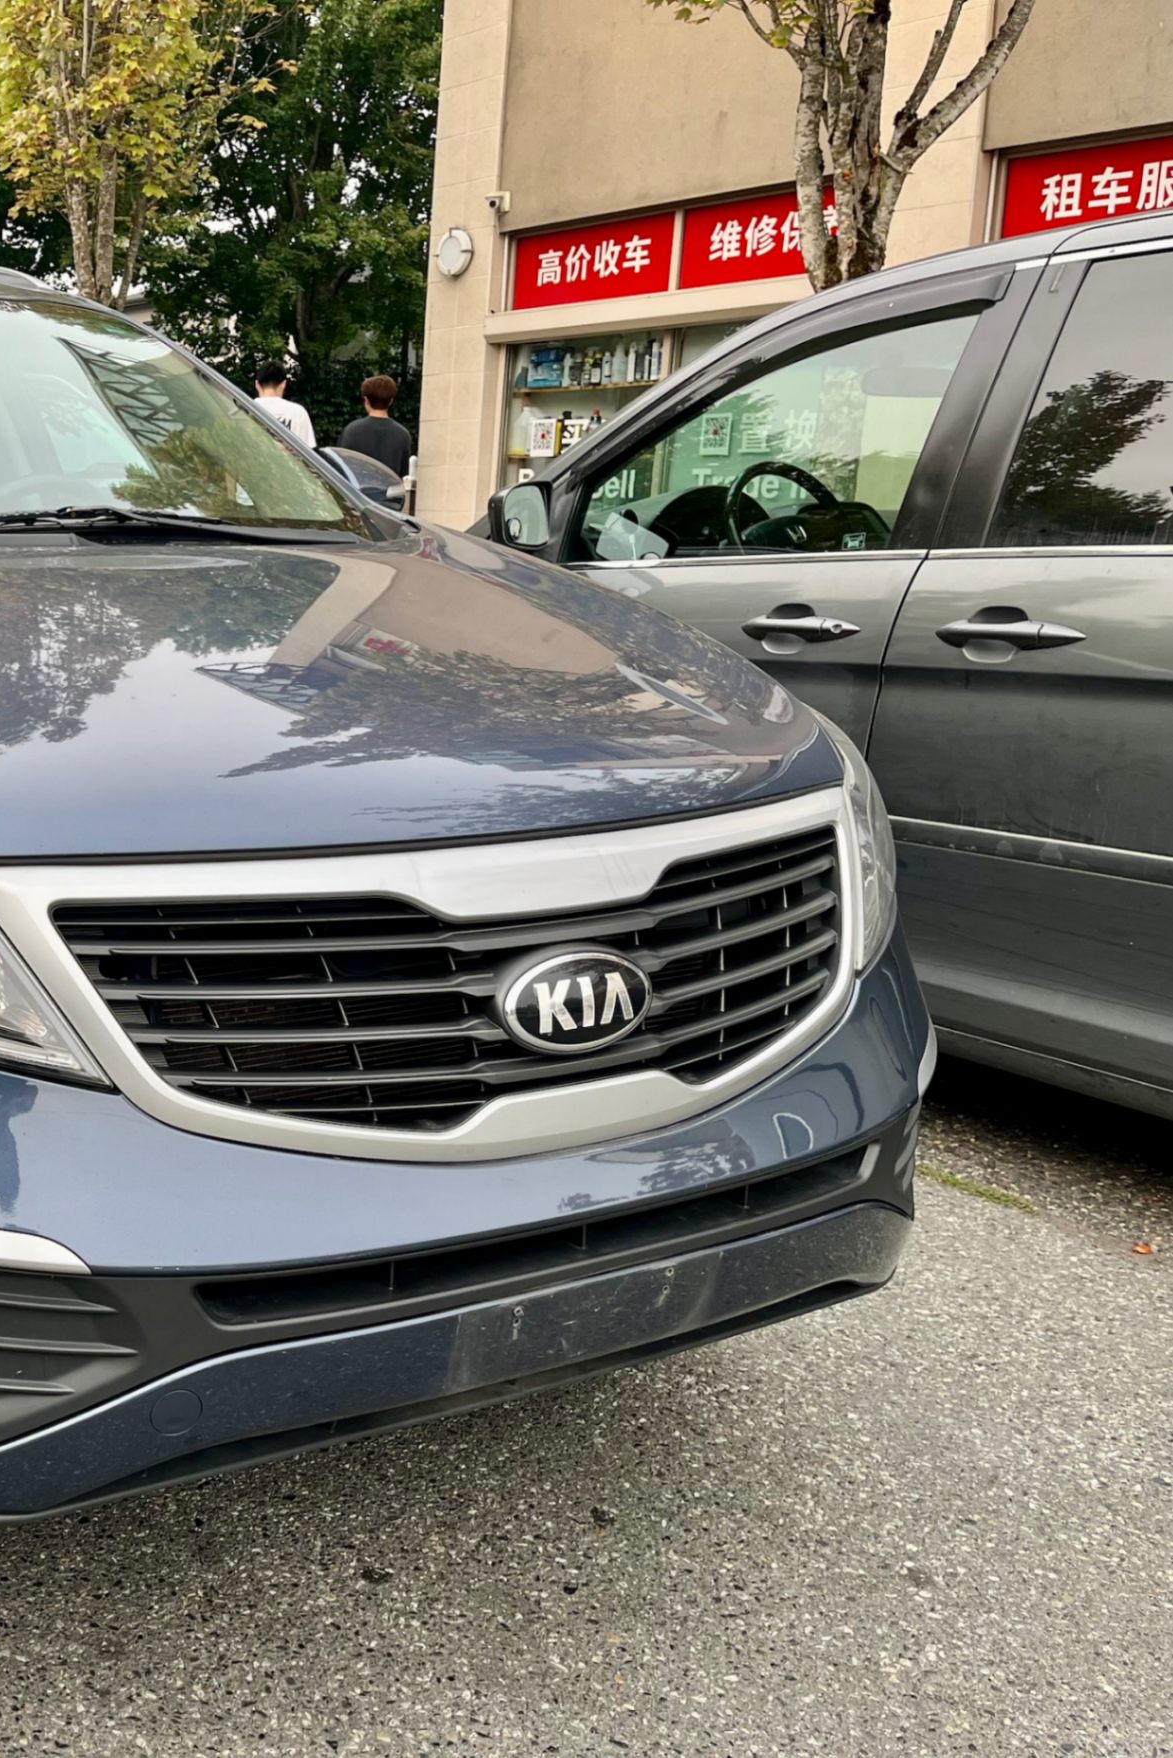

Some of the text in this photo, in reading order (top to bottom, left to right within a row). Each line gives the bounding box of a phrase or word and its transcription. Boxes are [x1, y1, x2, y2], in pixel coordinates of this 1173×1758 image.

[1039, 159, 1173, 222] 租车服
[536, 234, 652, 288] 高价收车
[737, 409, 817, 454] 置换
[691, 468, 779, 499] Trde
[533, 971, 635, 1036] KIA
